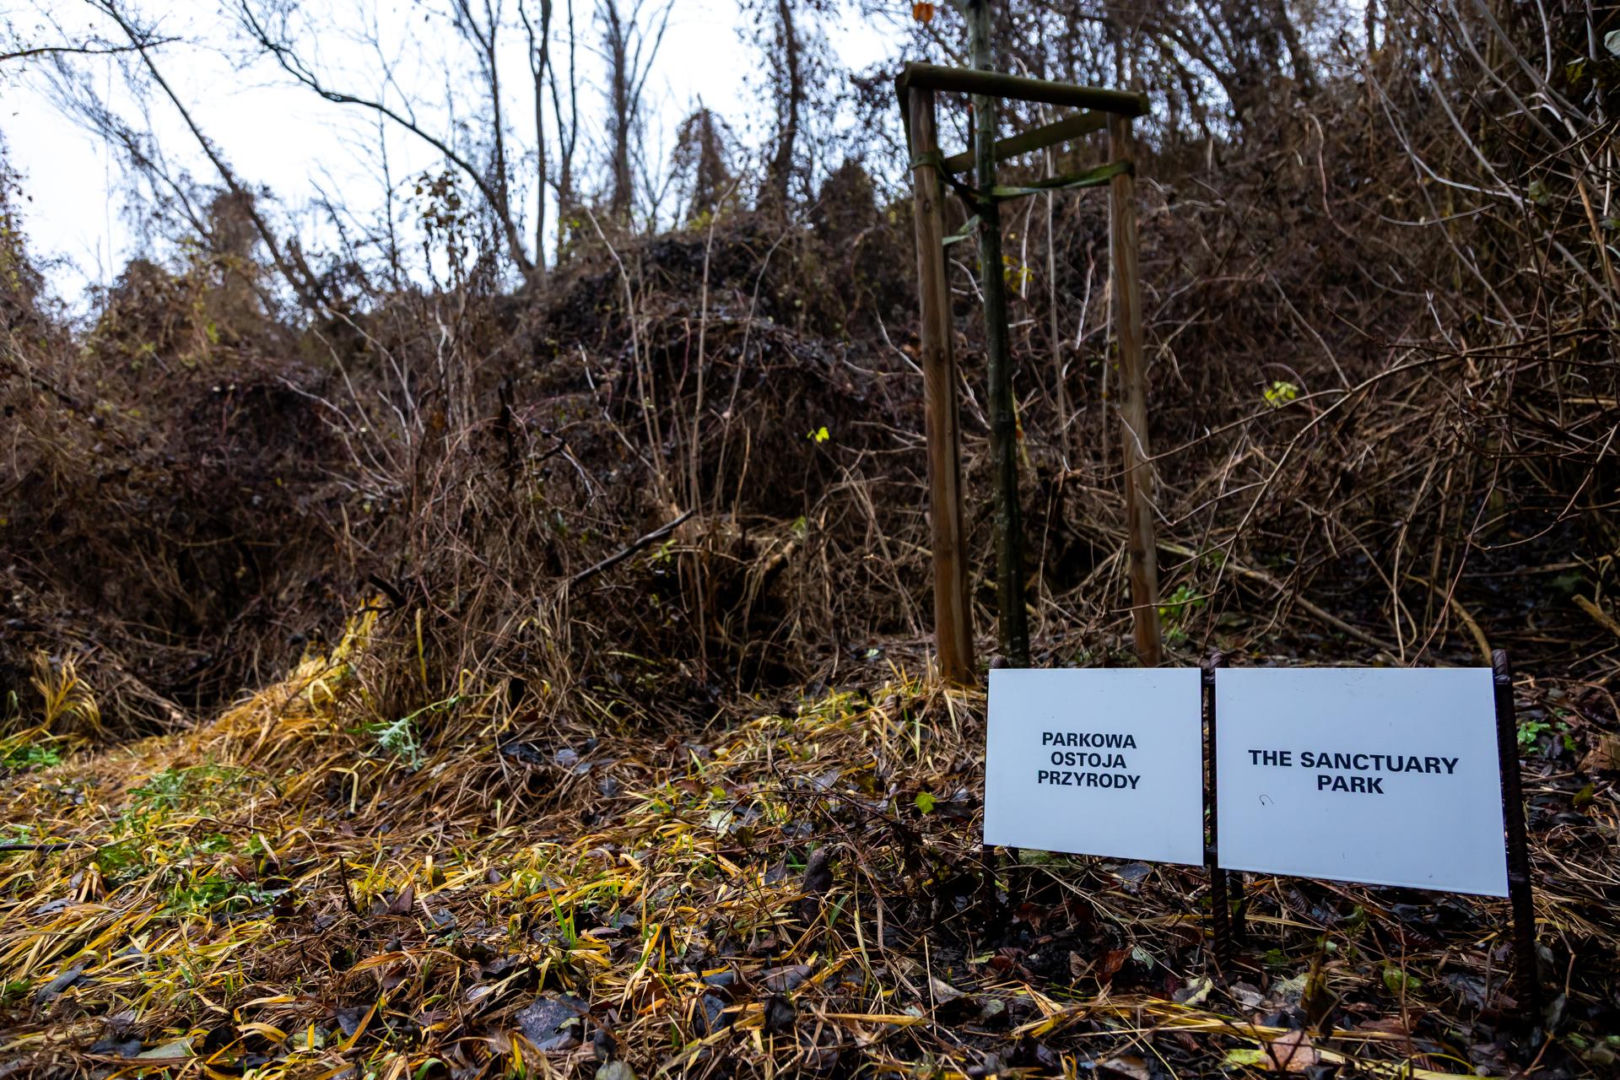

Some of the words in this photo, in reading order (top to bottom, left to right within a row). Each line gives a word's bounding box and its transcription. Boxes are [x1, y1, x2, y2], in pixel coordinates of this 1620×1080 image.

[1042, 732, 1137, 749] PARKOWA
[1051, 751, 1127, 769] OSTOJA
[1248, 749, 1292, 767] THE
[1300, 751, 1459, 774] SANCTUARY
[1038, 770, 1141, 790] PRZYRODY
[1317, 775, 1384, 794] PARK
